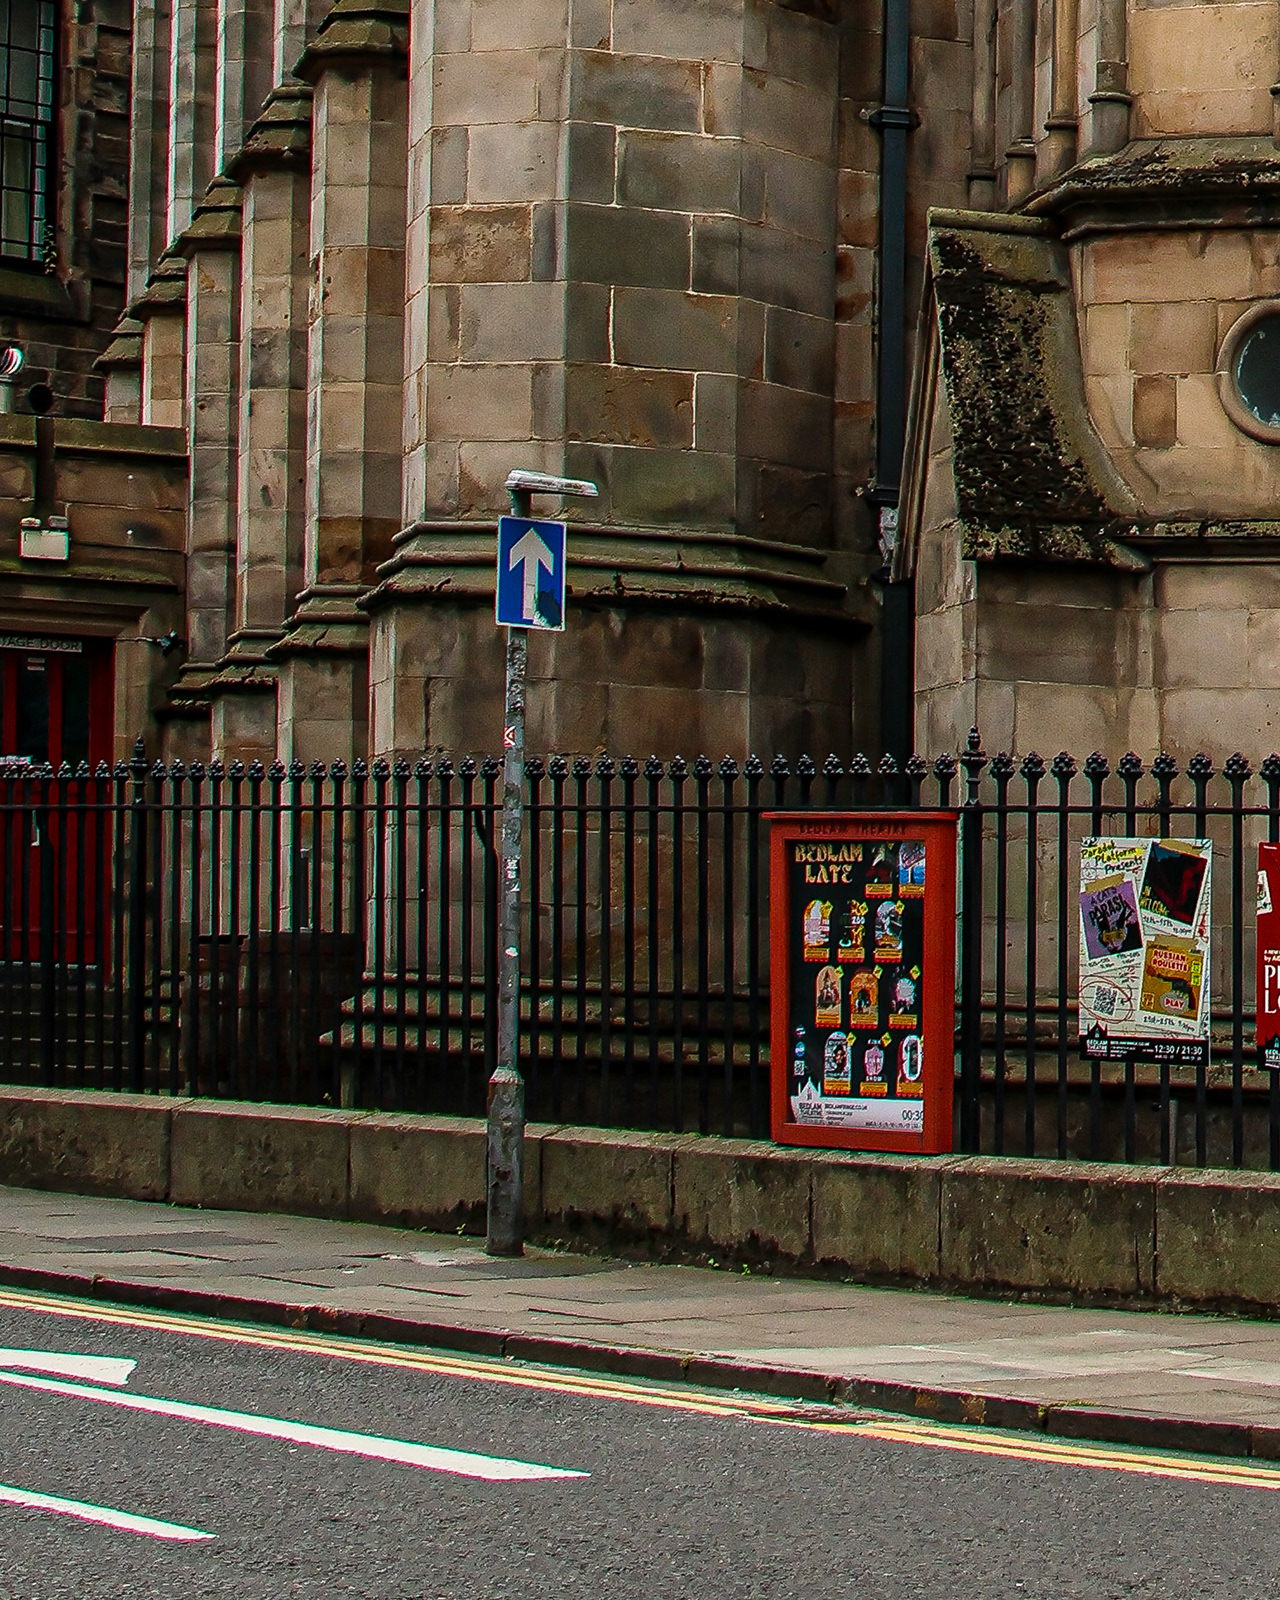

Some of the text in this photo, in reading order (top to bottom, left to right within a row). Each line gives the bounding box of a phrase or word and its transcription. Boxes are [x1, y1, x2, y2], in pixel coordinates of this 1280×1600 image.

[40, 640, 82, 651] DOOR
[795, 843, 863, 862] BEDLAM
[805, 864, 853, 883] LATE
[1153, 949, 1186, 962] RUSSIAN
[1152, 959, 1188, 972] ROULETTE
[1164, 998, 1184, 1008] PLAY
[1155, 1044, 1175, 1054] 12:30
[1181, 1045, 1203, 1055] 21:30
